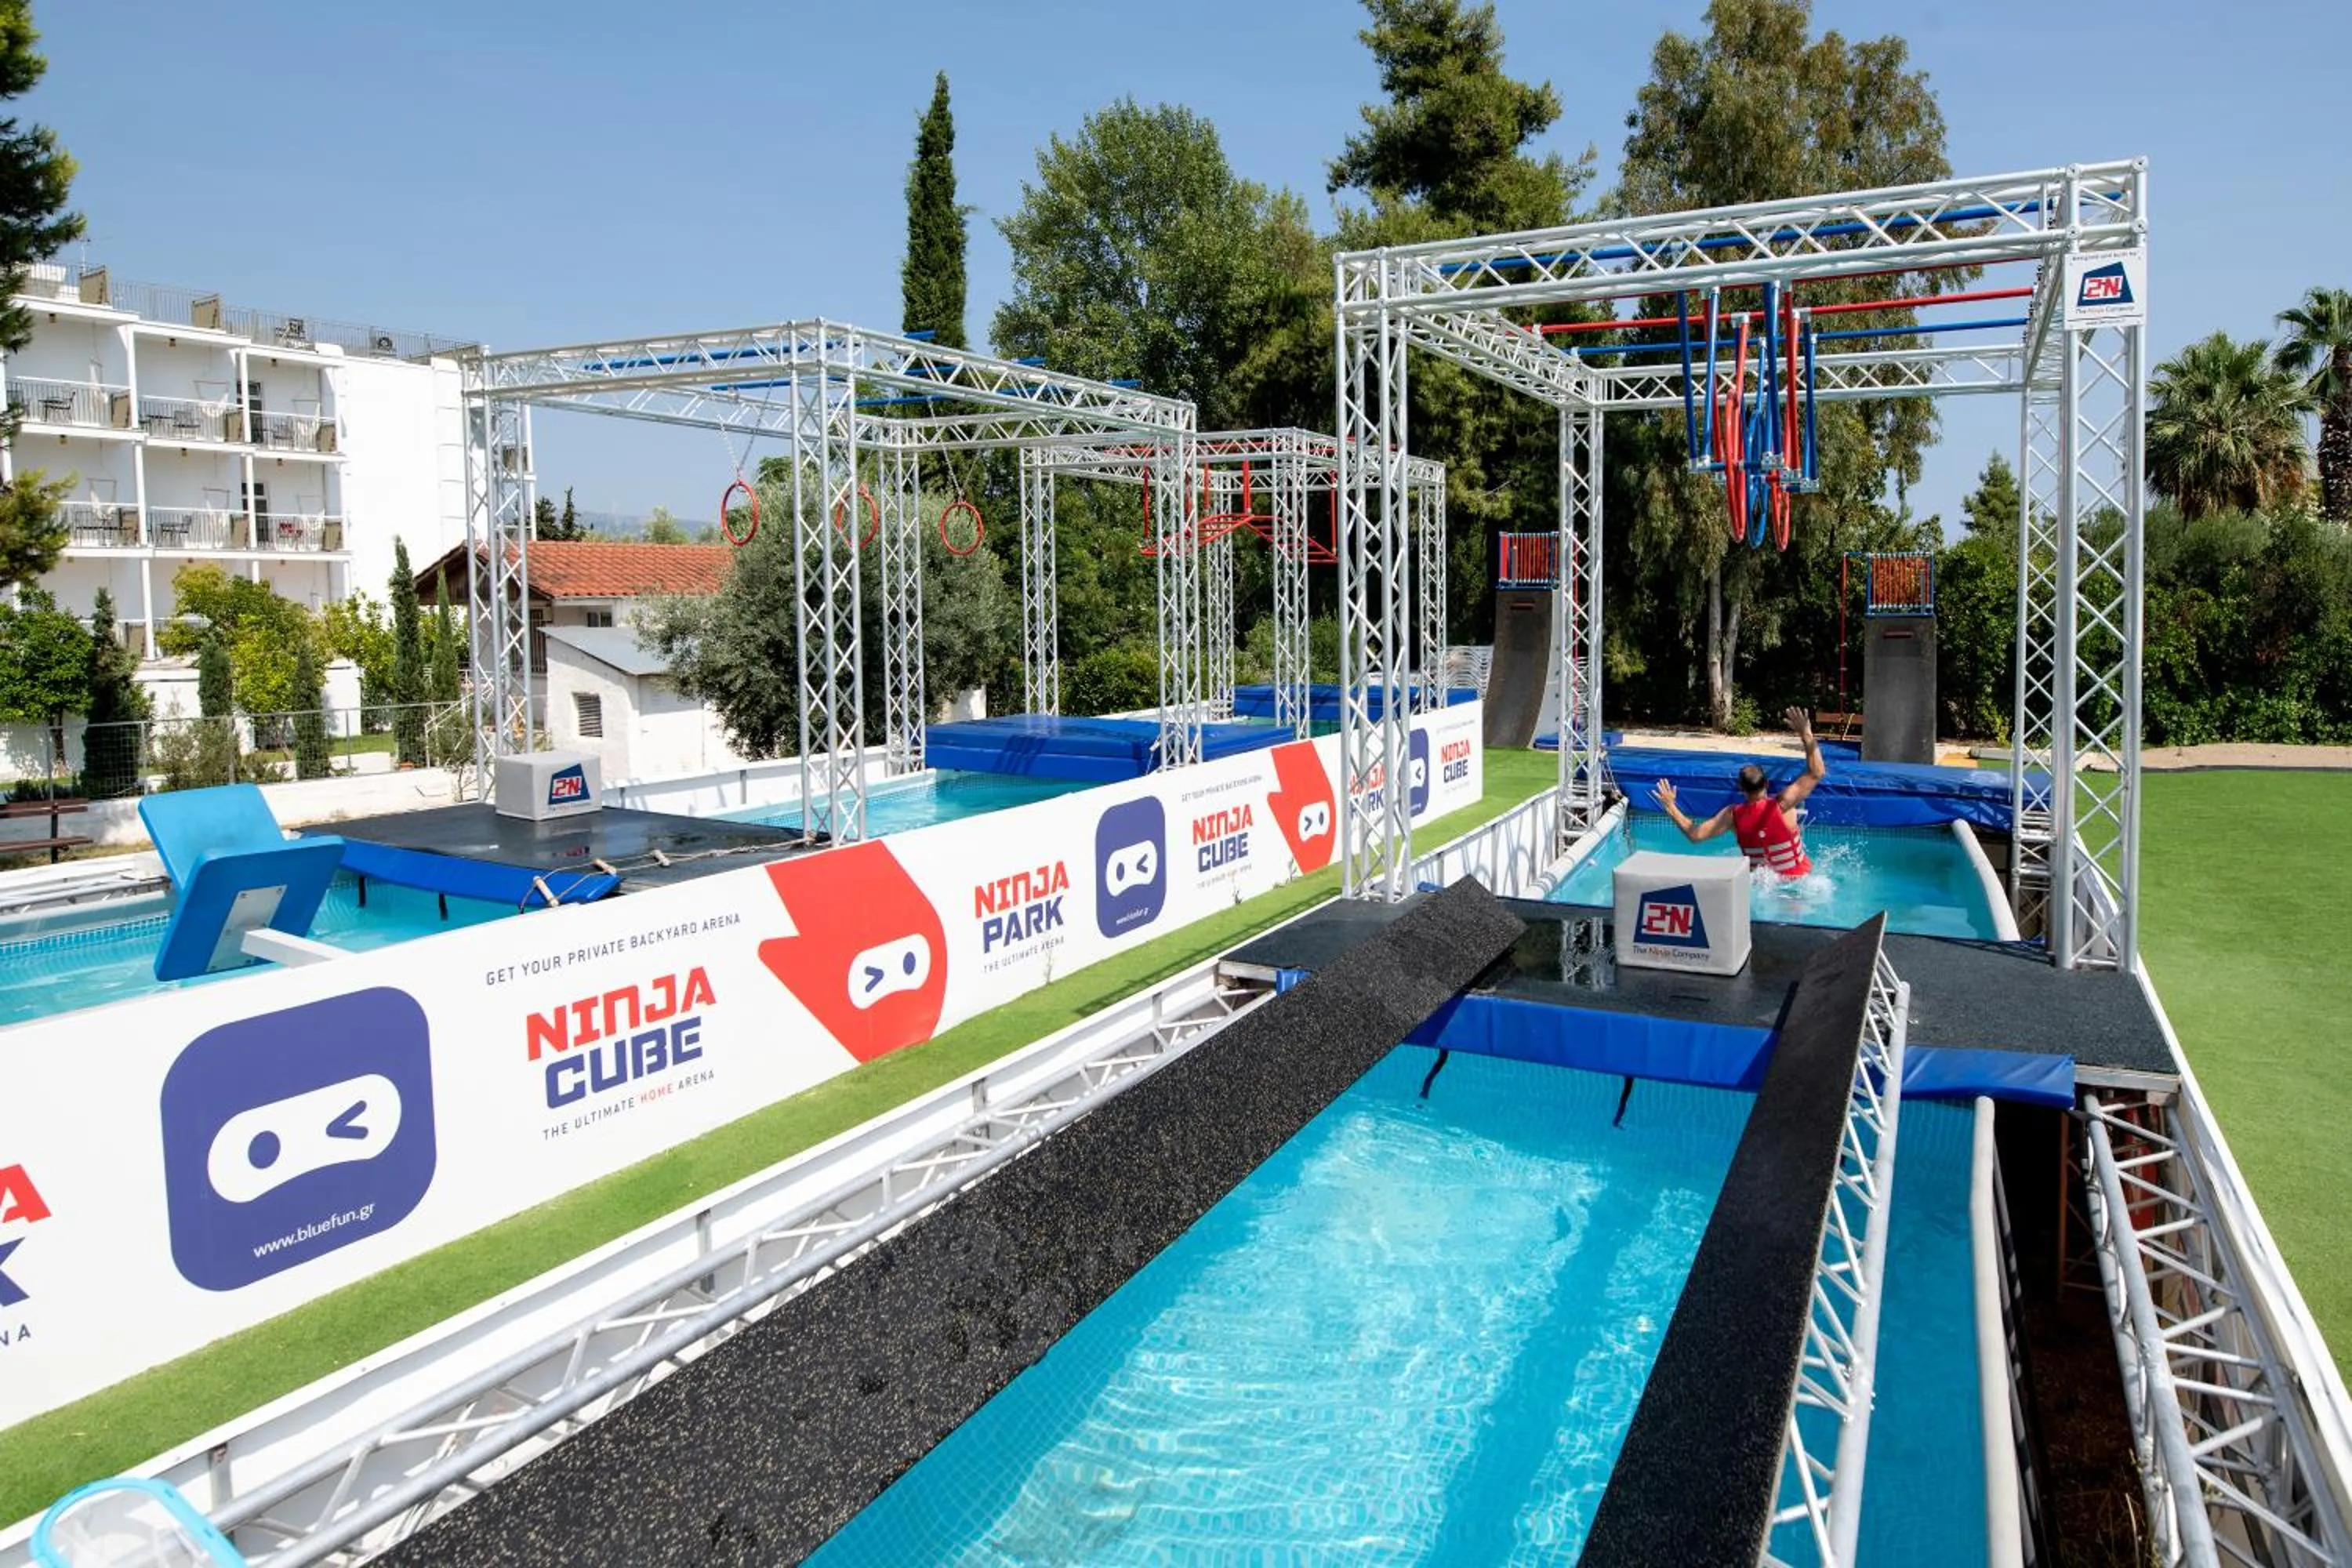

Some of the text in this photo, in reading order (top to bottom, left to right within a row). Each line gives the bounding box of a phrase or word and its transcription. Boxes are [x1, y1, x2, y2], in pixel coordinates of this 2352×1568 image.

[2085, 277, 2122, 298] 2N
[552, 777, 581, 797] 2N
[1443, 759, 1468, 783] CUBE
[1192, 804, 1253, 845] NINJA
[1350, 788, 1385, 819] PRK
[1198, 832, 1249, 873] CUBE
[975, 861, 1069, 919] NINJA
[983, 895, 1064, 954] PARK
[1643, 904, 1691, 935] 2N
[486, 913, 741, 985] GET YOUR PRIVATE BACKYARD ARENA
[526, 966, 717, 1062] NINJA
[545, 1016, 703, 1109] CUBE
[543, 1069, 715, 1141] THE ULTIMATE HOME ARENA
[253, 1203, 376, 1258] www.bluefun.gr
